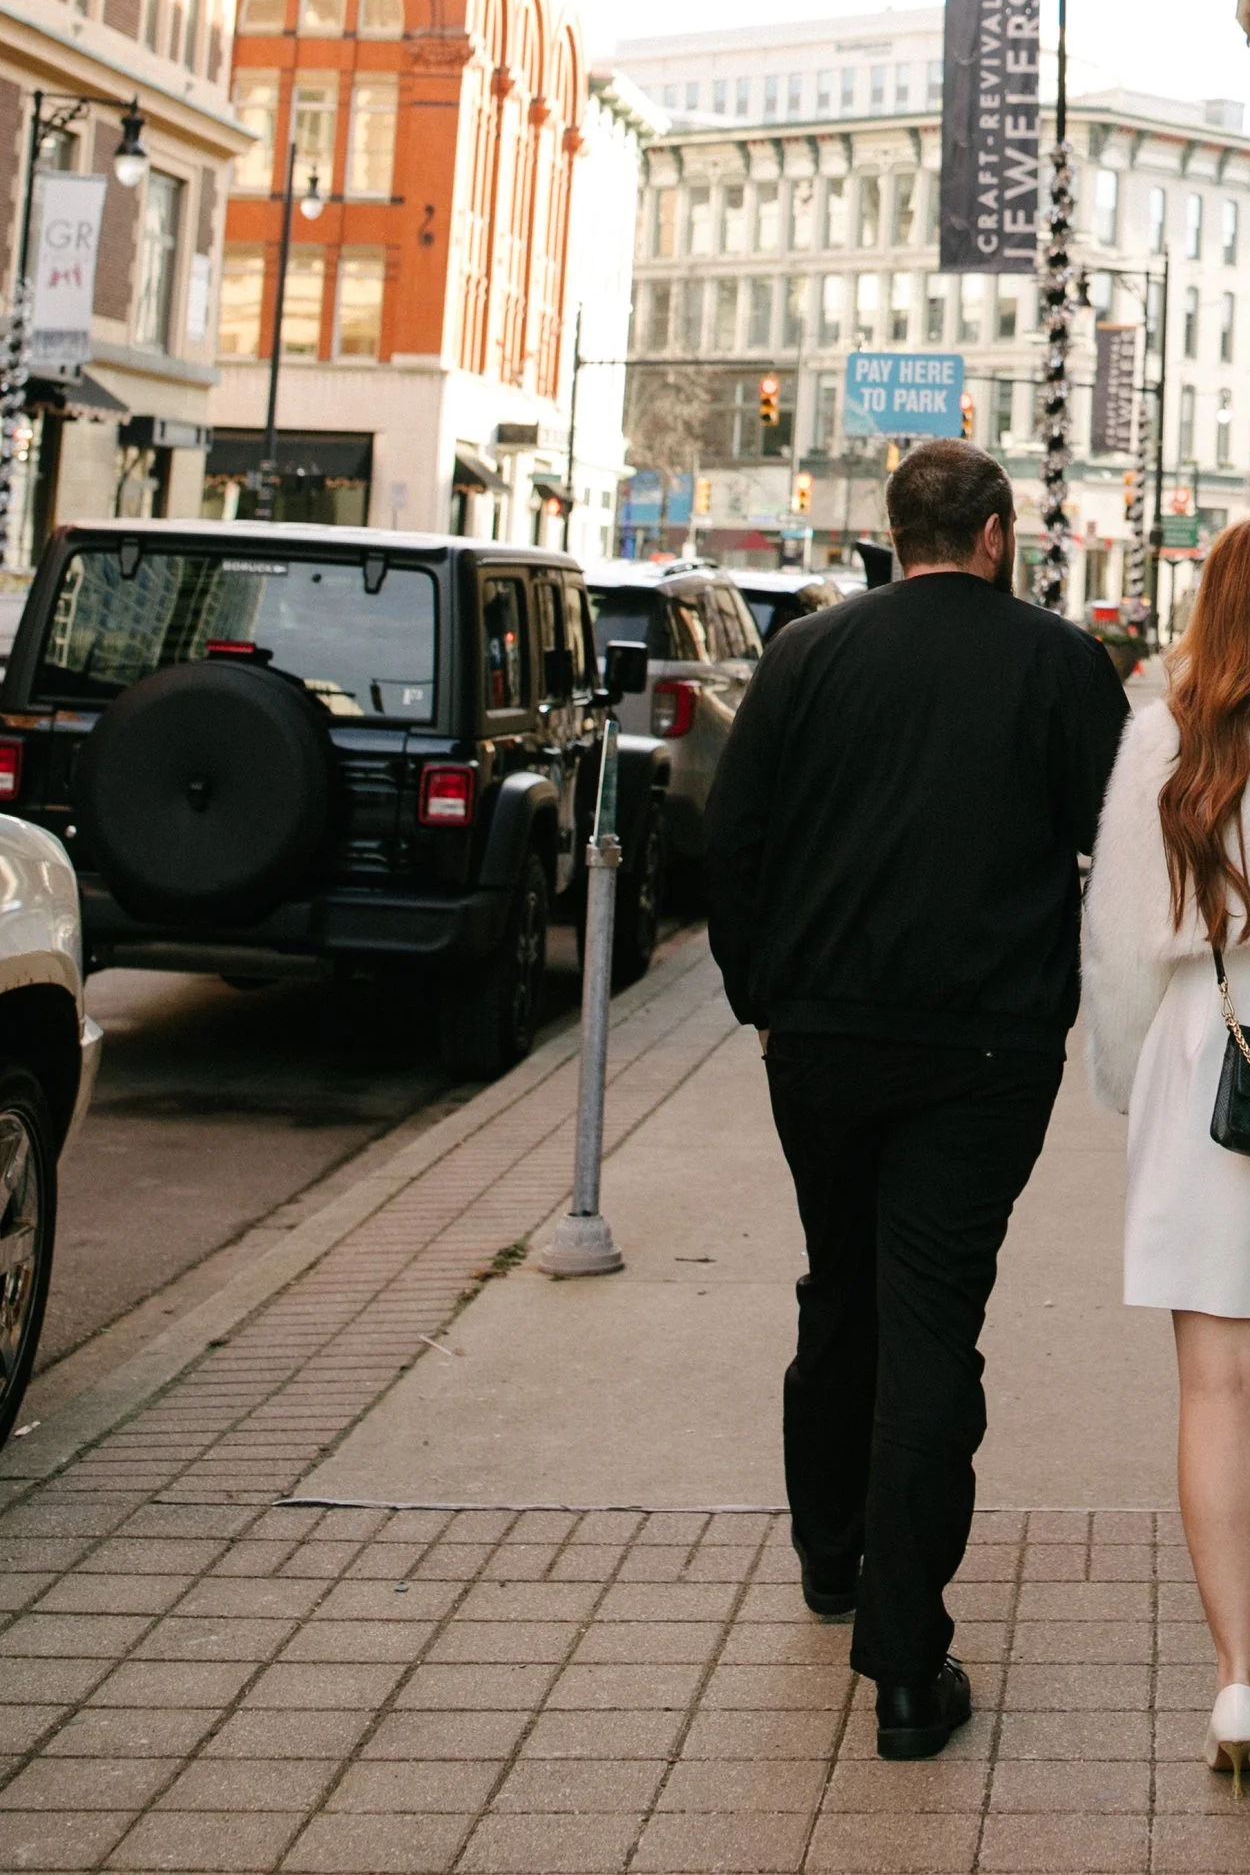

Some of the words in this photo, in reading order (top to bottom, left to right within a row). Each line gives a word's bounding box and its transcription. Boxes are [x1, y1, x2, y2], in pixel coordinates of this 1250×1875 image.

[855, 358, 893, 383] PAY
[899, 360, 955, 385] HERE
[860, 387, 886, 413] TO
[893, 388, 948, 414] PARK
